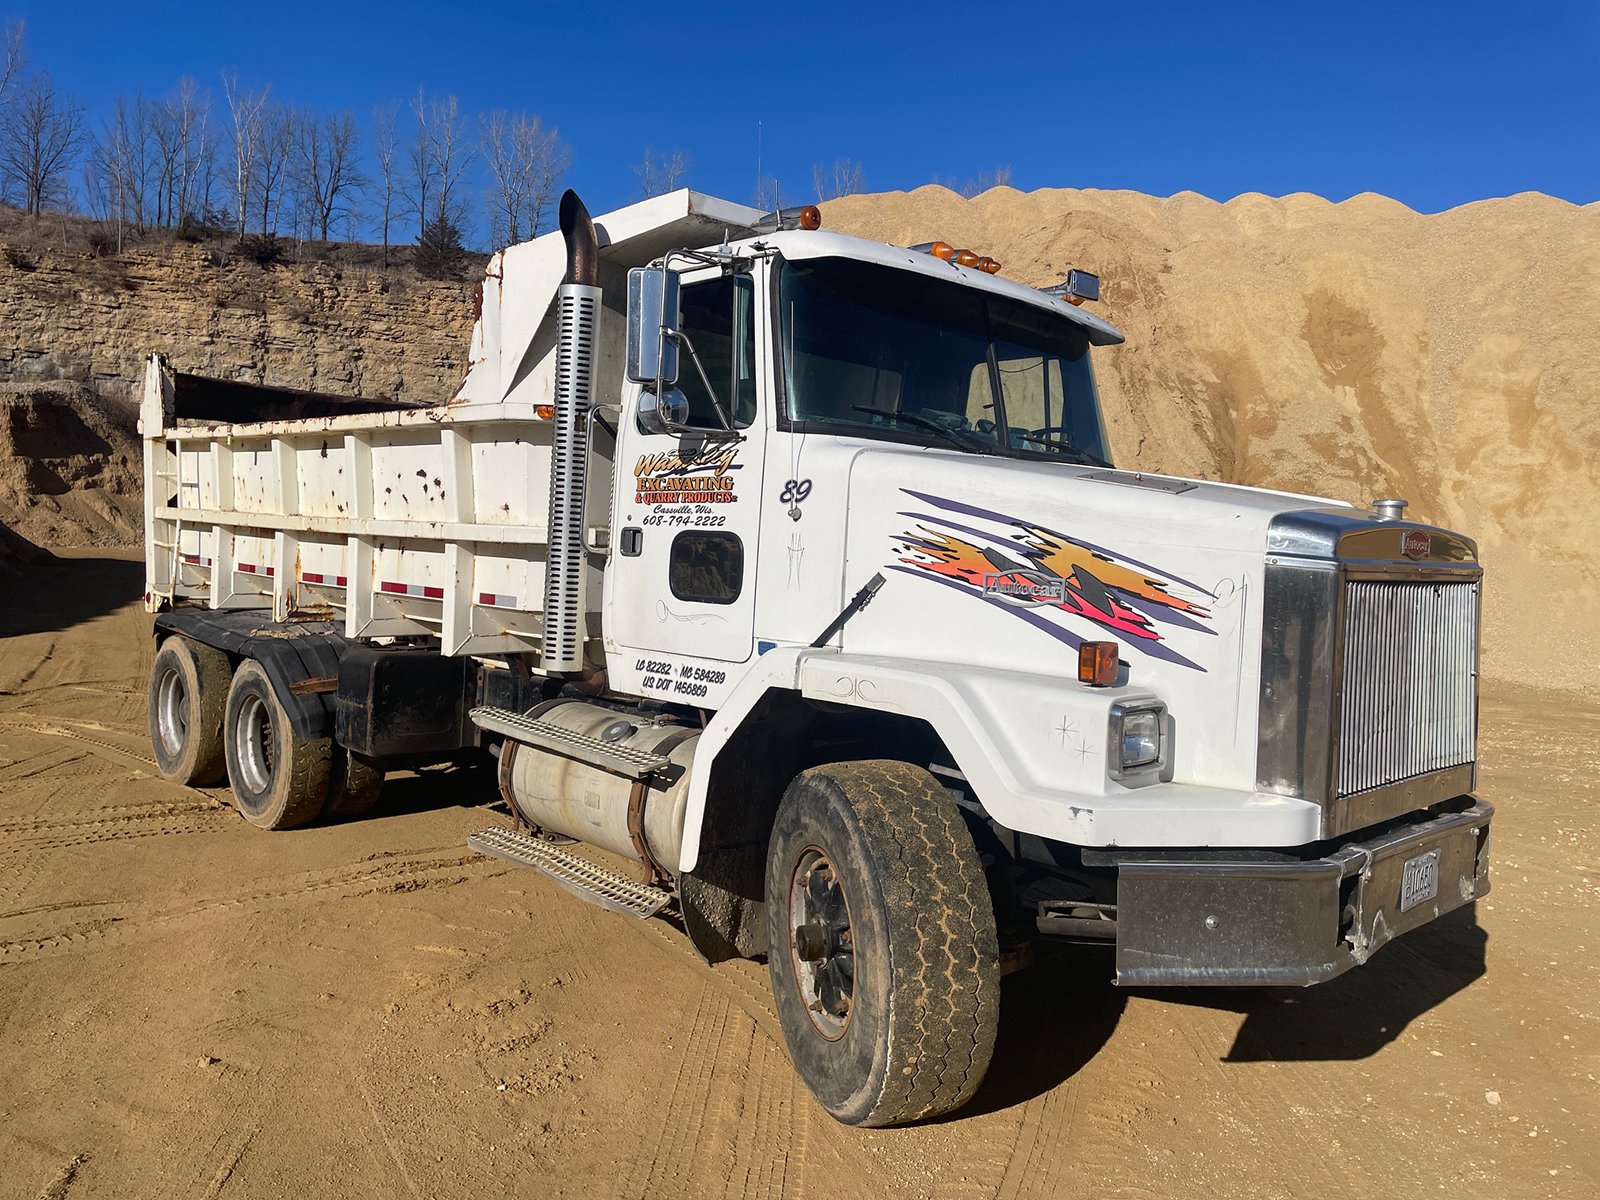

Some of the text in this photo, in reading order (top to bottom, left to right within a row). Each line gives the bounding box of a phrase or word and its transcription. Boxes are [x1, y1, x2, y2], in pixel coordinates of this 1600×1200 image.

[636, 476, 735, 492] EXCAVATING
[779, 478, 813, 504] 89
[635, 492, 643, 504] &
[643, 491, 680, 505] QUARRY
[681, 491, 732, 504] PRODUCTS
[653, 504, 693, 515] Cassville,
[642, 515, 727, 527] 608-794-2222
[988, 576, 1062, 598] Autocar
[646, 660, 672, 675] 82282
[680, 666, 693, 679] MC
[693, 668, 726, 684] 584289
[642, 675, 707, 697] US DOT 1456869
